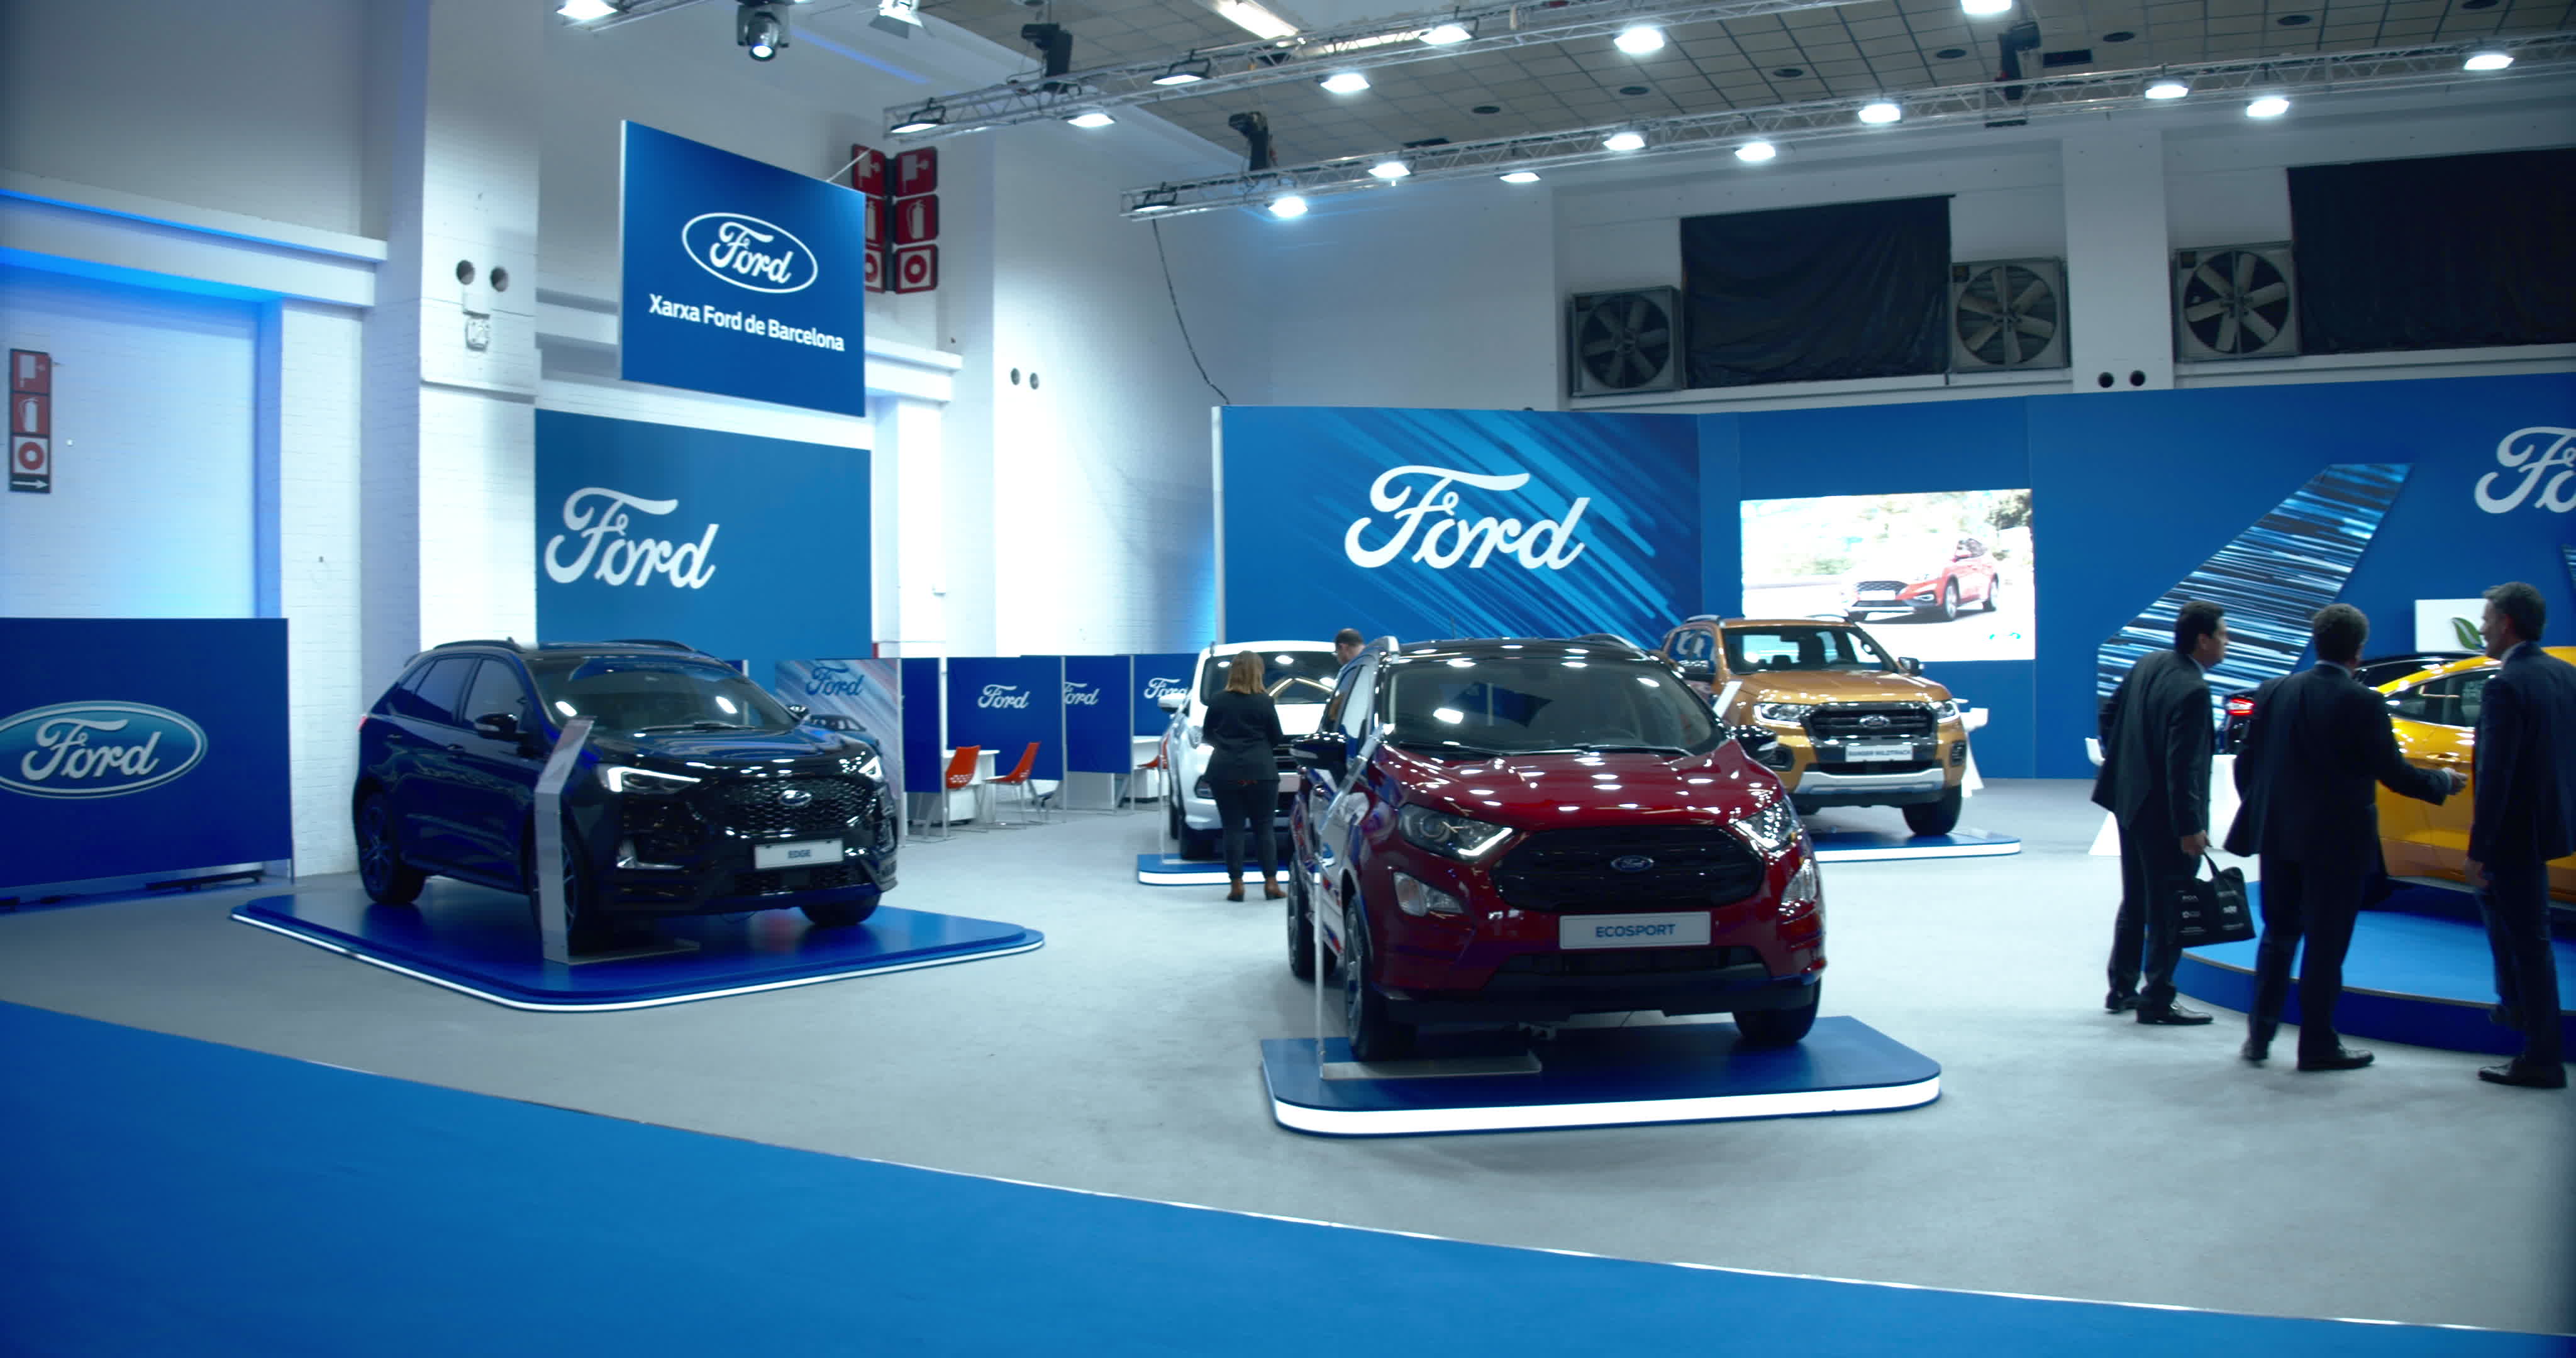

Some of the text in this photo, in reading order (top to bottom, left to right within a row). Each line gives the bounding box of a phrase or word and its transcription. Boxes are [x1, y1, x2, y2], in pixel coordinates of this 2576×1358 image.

[709, 221, 794, 284] Ford
[649, 293, 845, 352] Xarxa Ford de Barcelona
[544, 487, 719, 590] Ford
[1344, 465, 1591, 570] Ford
[806, 666, 865, 696] Ford
[977, 684, 1030, 709] Ford
[21, 717, 162, 781] Ford
[787, 849, 811, 859] EDGE
[1595, 924, 1676, 938] ECOSPORT
